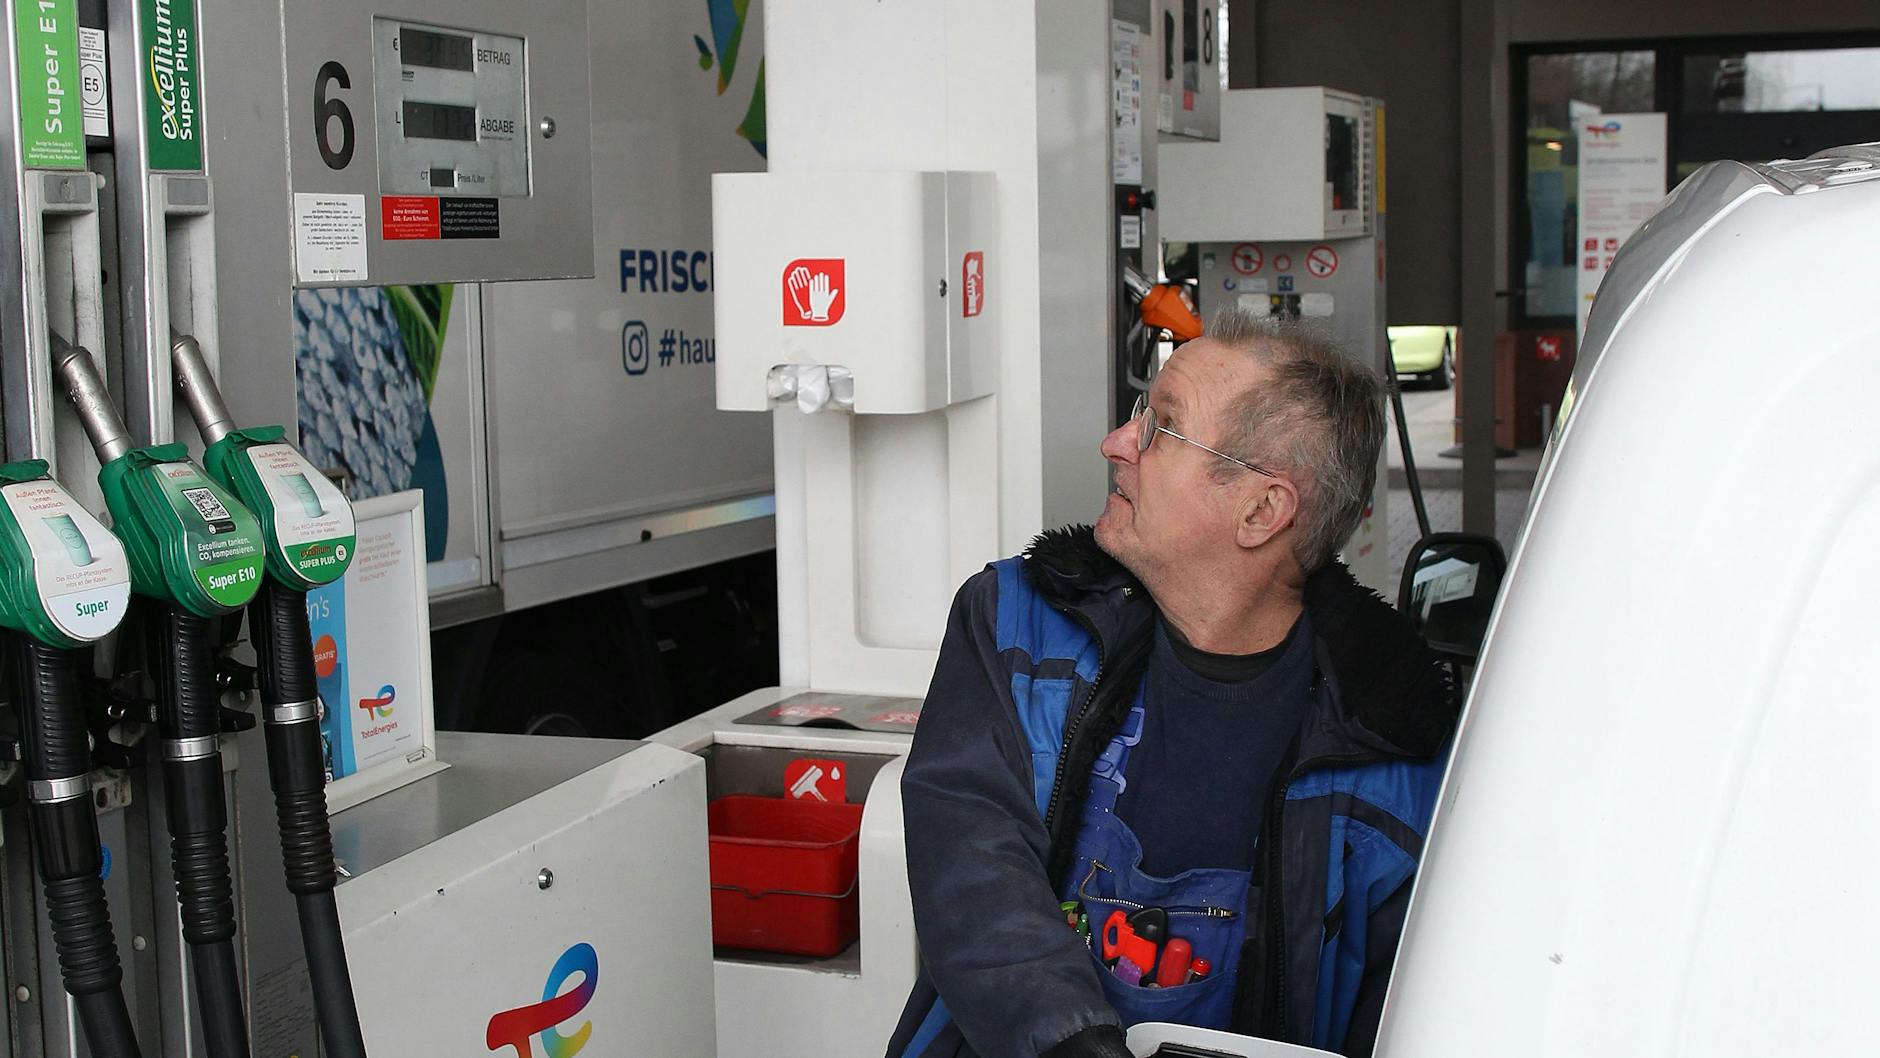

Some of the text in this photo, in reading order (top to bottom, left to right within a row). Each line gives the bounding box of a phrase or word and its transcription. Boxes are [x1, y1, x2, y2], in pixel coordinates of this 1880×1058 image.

[1203, 7, 1213, 65] 8
[477, 49, 511, 66] BETRAG
[153, 0, 178, 140] excellium
[45, 43, 64, 134] Super
[84, 77, 99, 92] E5
[175, 28, 194, 140] Super Plus
[313, 60, 355, 171] 6
[395, 111, 401, 124] L
[480, 118, 515, 134] ABGABE
[420, 171, 429, 181] CT
[458, 173, 471, 183] Preis
[197, 541, 228, 551] Excellium
[299, 556, 336, 569] SUPER PLUS
[208, 566, 256, 590] Super E10
[75, 600, 109, 618] Super
[361, 721, 398, 740] TotalEnergies
